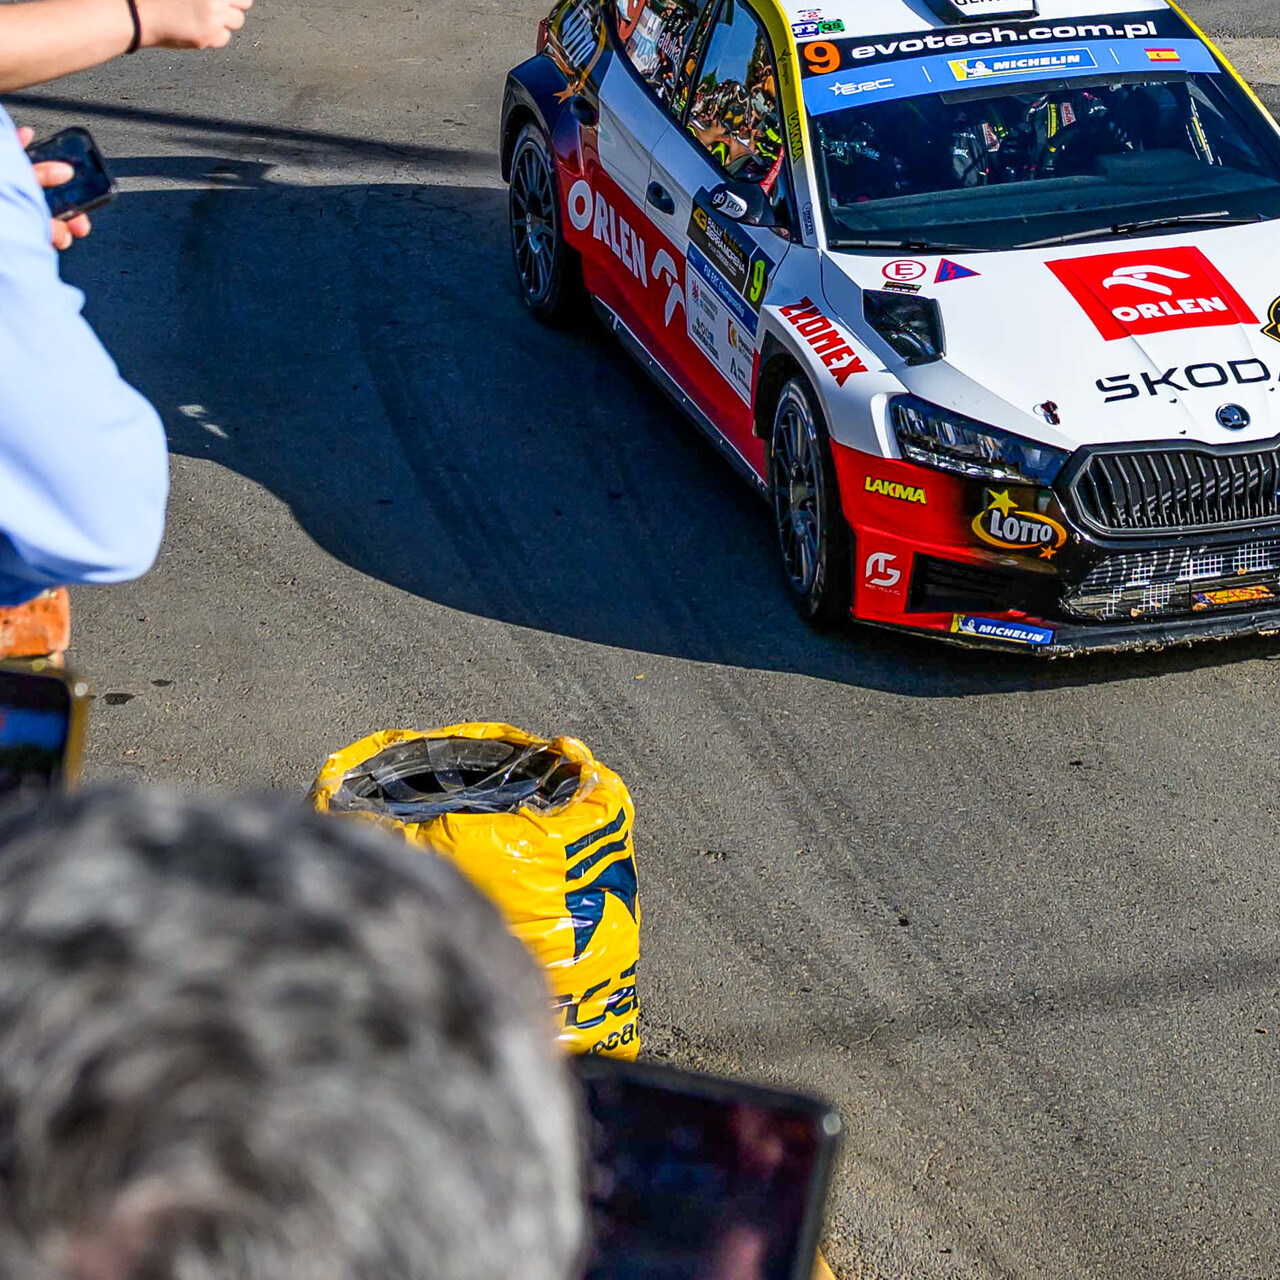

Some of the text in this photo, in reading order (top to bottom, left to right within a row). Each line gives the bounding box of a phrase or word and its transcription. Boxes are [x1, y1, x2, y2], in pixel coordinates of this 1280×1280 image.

[792, 23, 818, 36] FP
[821, 21, 843, 32] QS
[803, 40, 842, 75] 9
[851, 20, 1158, 60] evotech.com.pl
[993, 53, 1081, 71] MICHELIN
[693, 206, 708, 231] 43
[567, 179, 648, 289] ORLEN
[749, 259, 766, 303] 9
[895, 263, 914, 276] E
[1111, 297, 1228, 322] ORLEN
[864, 476, 928, 505] LAKMA
[989, 508, 1053, 543] LOTTO
[864, 582, 901, 596] RECYCLING
[978, 624, 1045, 643] MICHELIN
